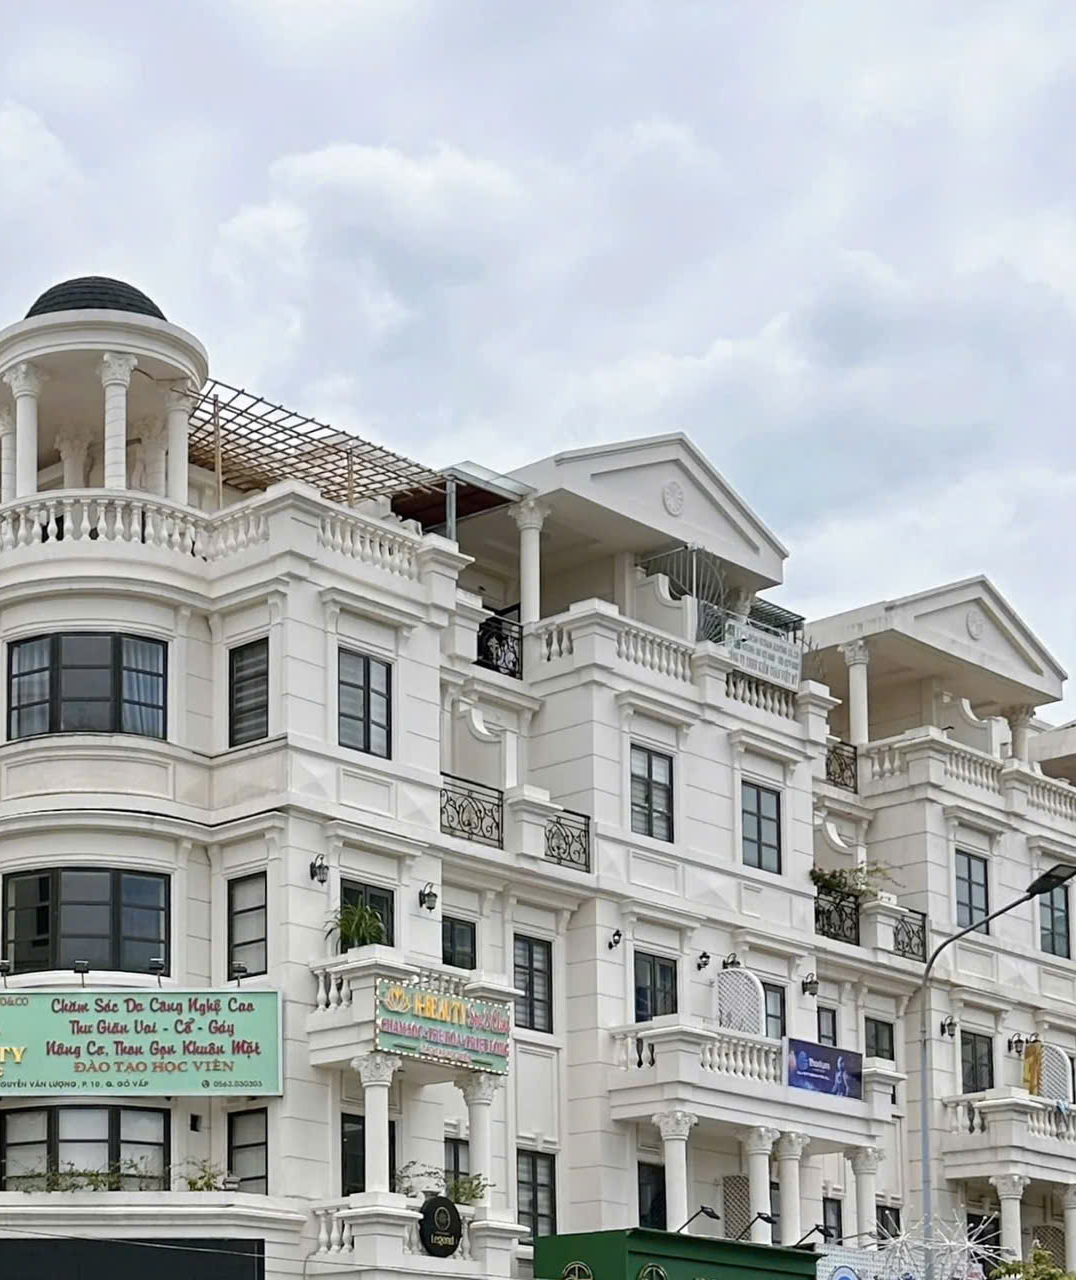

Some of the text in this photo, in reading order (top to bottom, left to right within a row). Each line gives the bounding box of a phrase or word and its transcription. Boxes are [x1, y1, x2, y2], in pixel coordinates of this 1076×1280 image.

[51, 997, 255, 1016] Chăm Sóc Da Công Nghệ Cao
[134, 1020, 157, 1034] Vai
[208, 1019, 234, 1037] Gáy
[46, 1040, 81, 1058] Nâng
[113, 1040, 143, 1056] Thon
[149, 1041, 176, 1059] Gọn
[182, 1040, 225, 1056] Khuôn
[232, 1039, 261, 1058] Mặt
[74, 1058, 234, 1075] ĐÀO TẠO HỌC VIÊN
